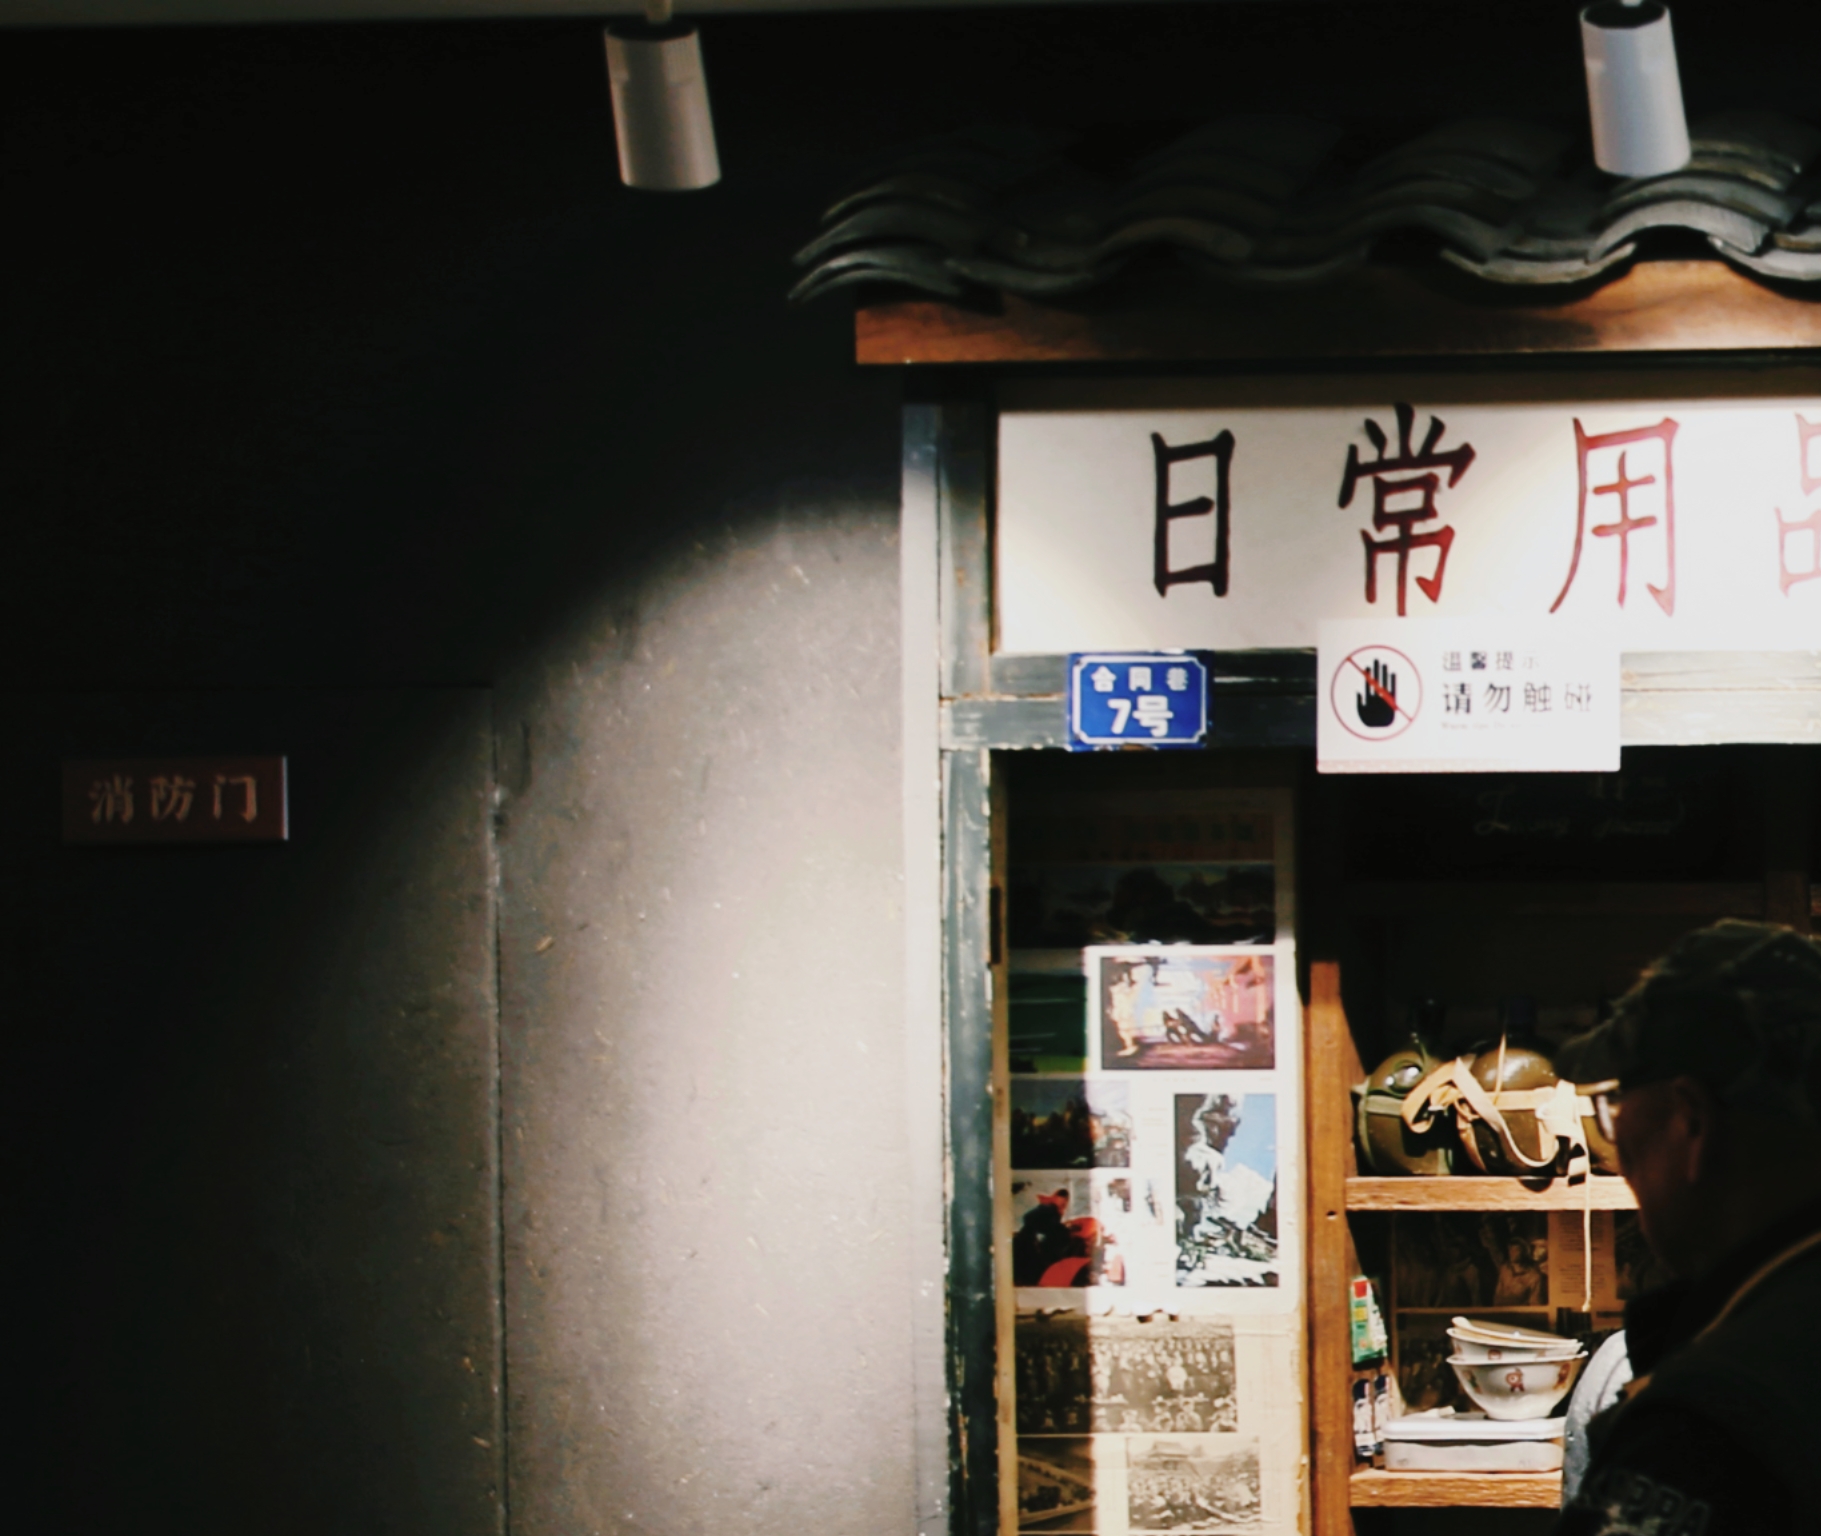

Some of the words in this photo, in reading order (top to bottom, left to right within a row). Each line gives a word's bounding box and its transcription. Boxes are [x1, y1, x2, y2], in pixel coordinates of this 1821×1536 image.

[1106, 696, 1175, 738] 7号
[1442, 681, 1592, 715] 请勿触碰
[89, 774, 257, 824] 消防门
